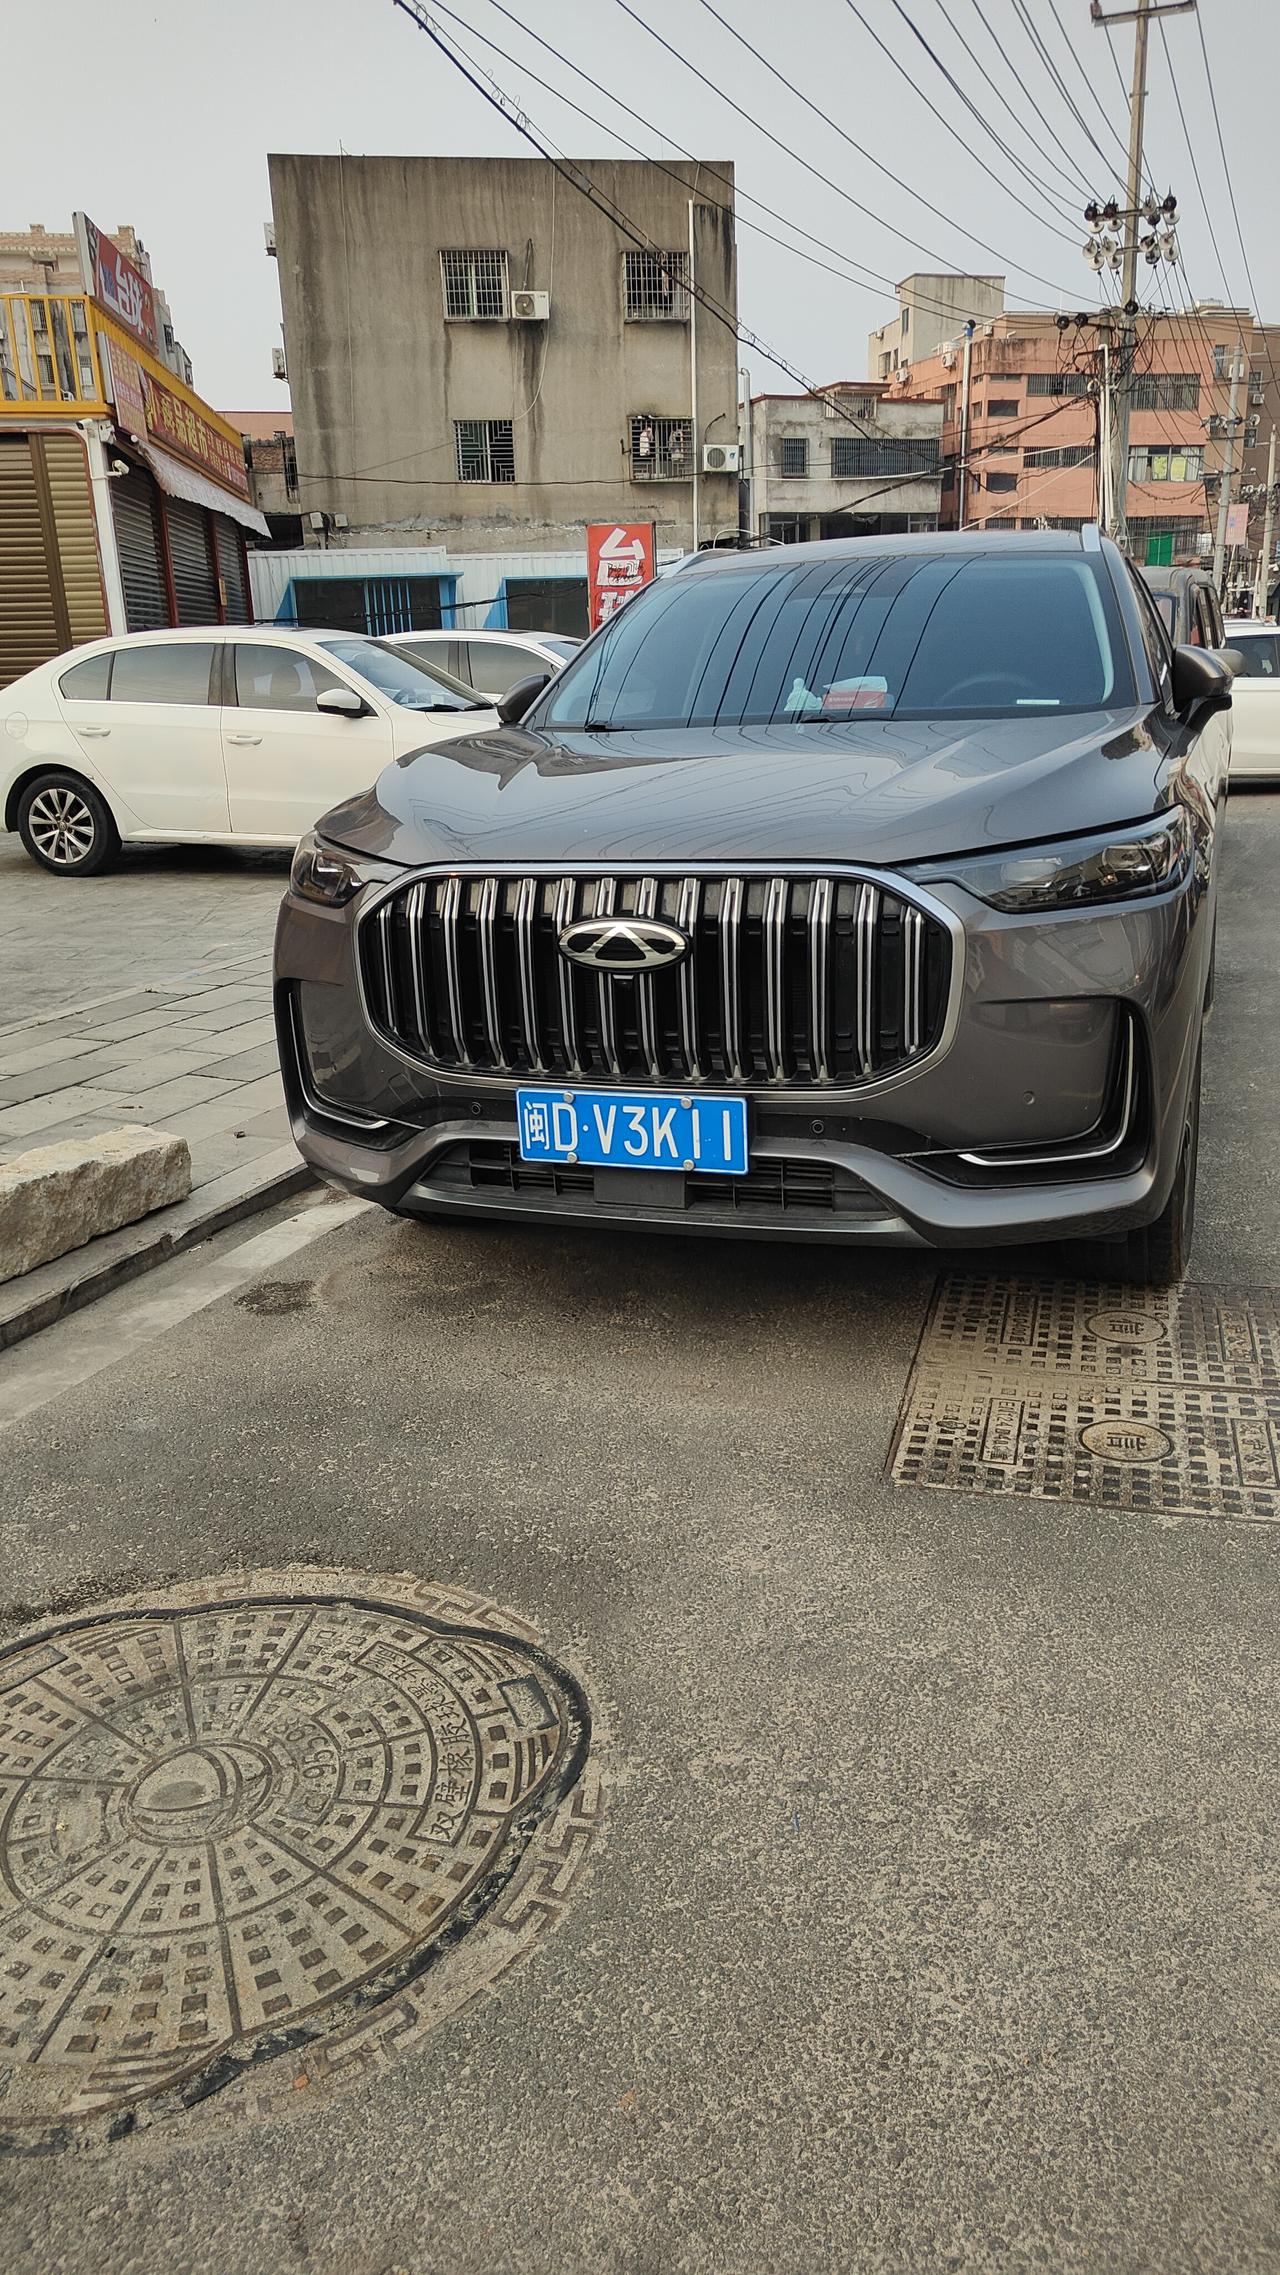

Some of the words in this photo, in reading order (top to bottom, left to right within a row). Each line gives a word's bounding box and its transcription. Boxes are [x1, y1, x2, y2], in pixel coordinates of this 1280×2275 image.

[366, 1645, 475, 1839] 双壁橡胶球墨井盖
